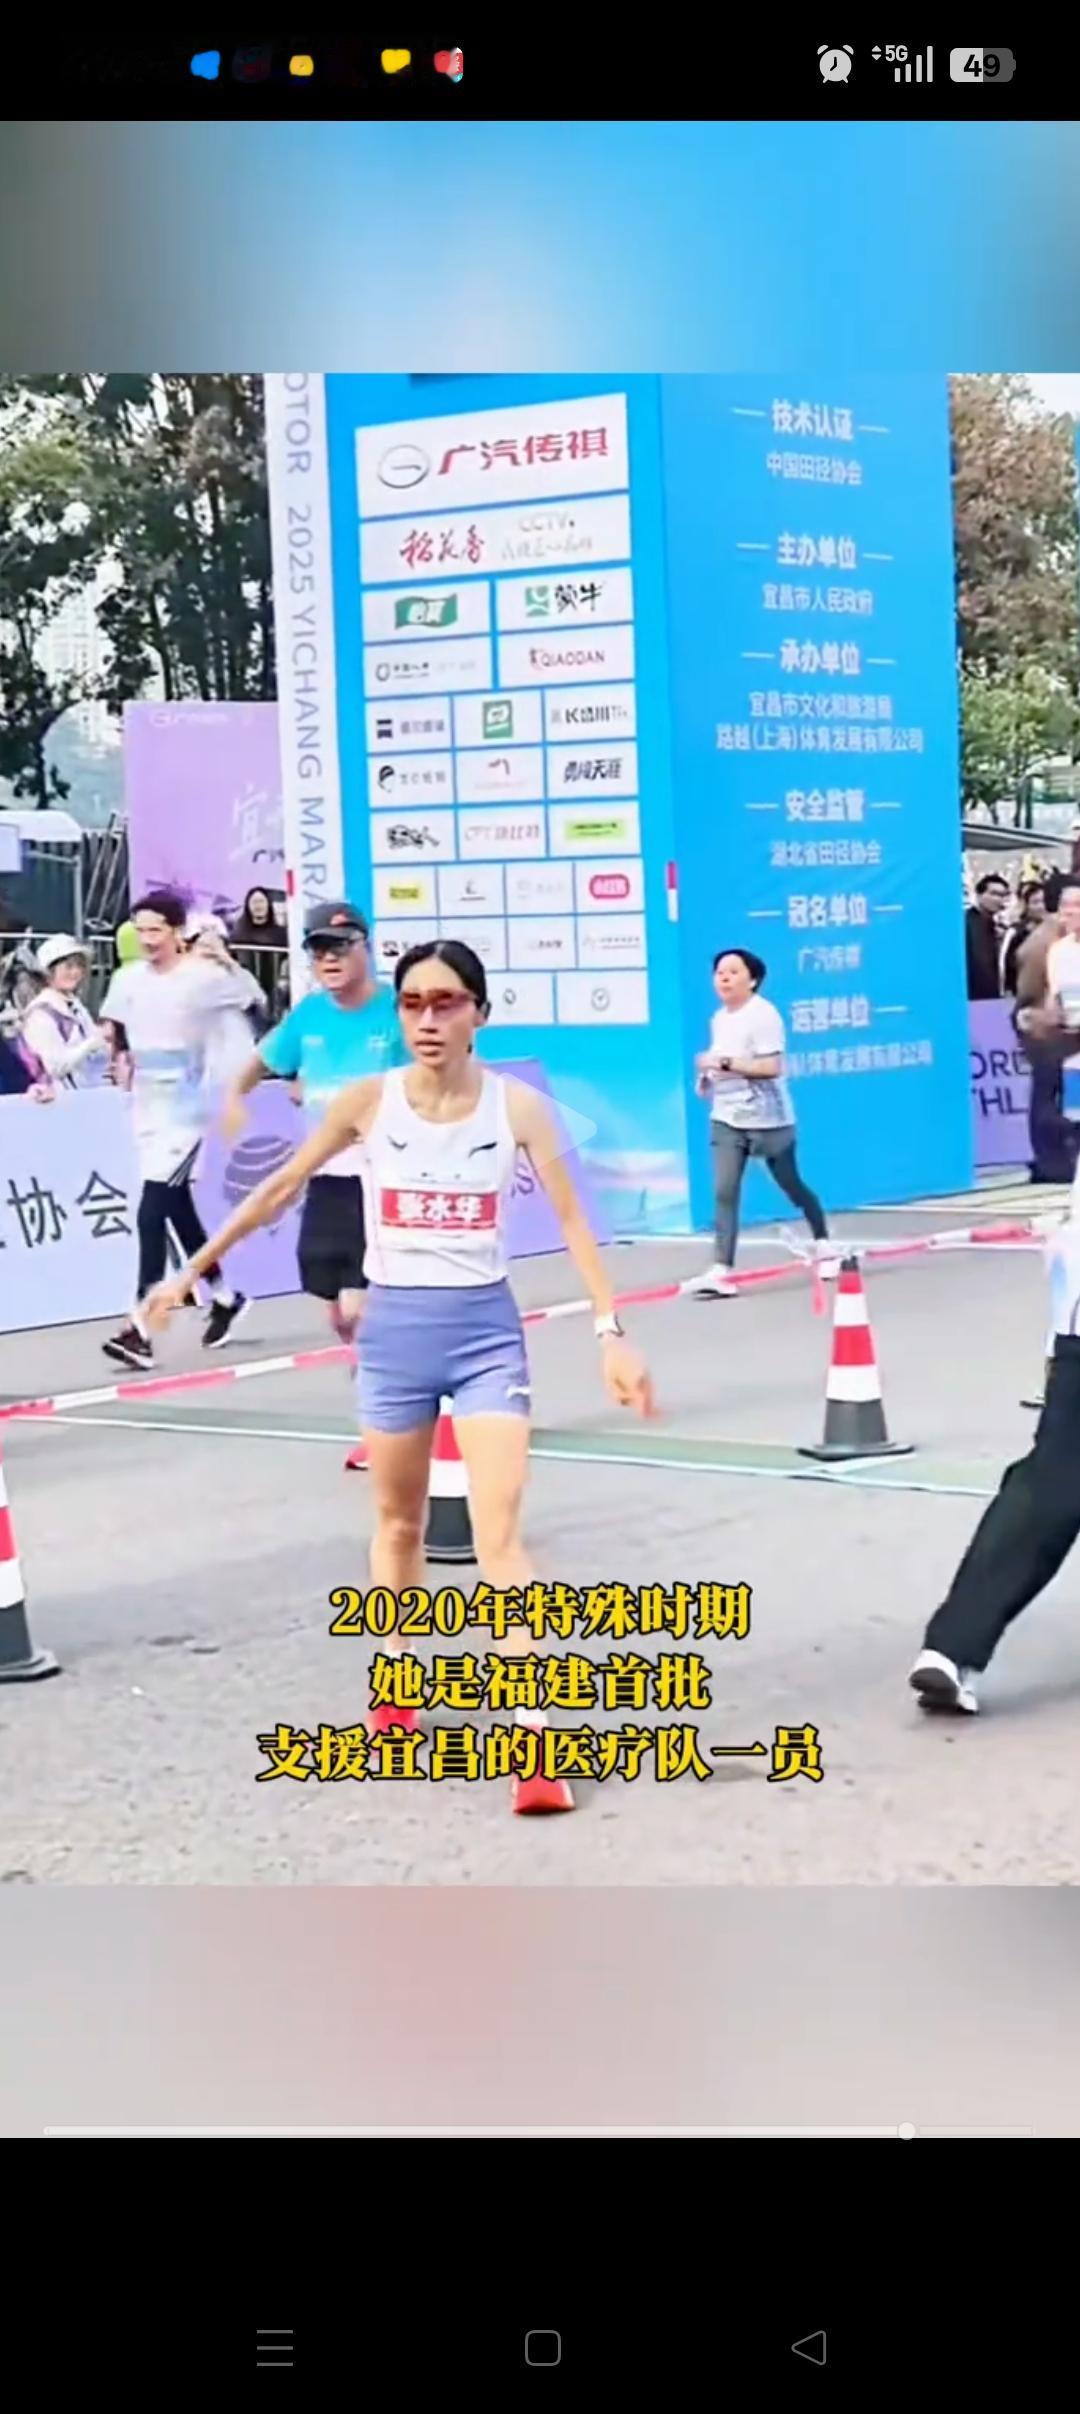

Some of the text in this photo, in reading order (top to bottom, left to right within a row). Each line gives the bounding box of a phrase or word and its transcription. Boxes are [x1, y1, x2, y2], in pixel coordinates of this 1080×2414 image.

[885, 45, 908, 62] 5G
[963, 54, 1000, 77] 49
[772, 399, 854, 440] 技术认证
[437, 426, 609, 476] 广汽传祺
[766, 450, 862, 485] 中国田径协会
[288, 504, 316, 594] 2025
[776, 533, 857, 569] 主办单位
[554, 582, 603, 614] 蒙牛
[762, 583, 873, 615] 宜昌市人民政府
[541, 649, 605, 669] QIAODAN
[779, 638, 861, 675] 承办单位
[291, 604, 322, 779] YICHANG
[788, 894, 869, 928] 冠名单位
[971, 1086, 1030, 1118] HL
[0, 1170, 132, 1249] 协会
